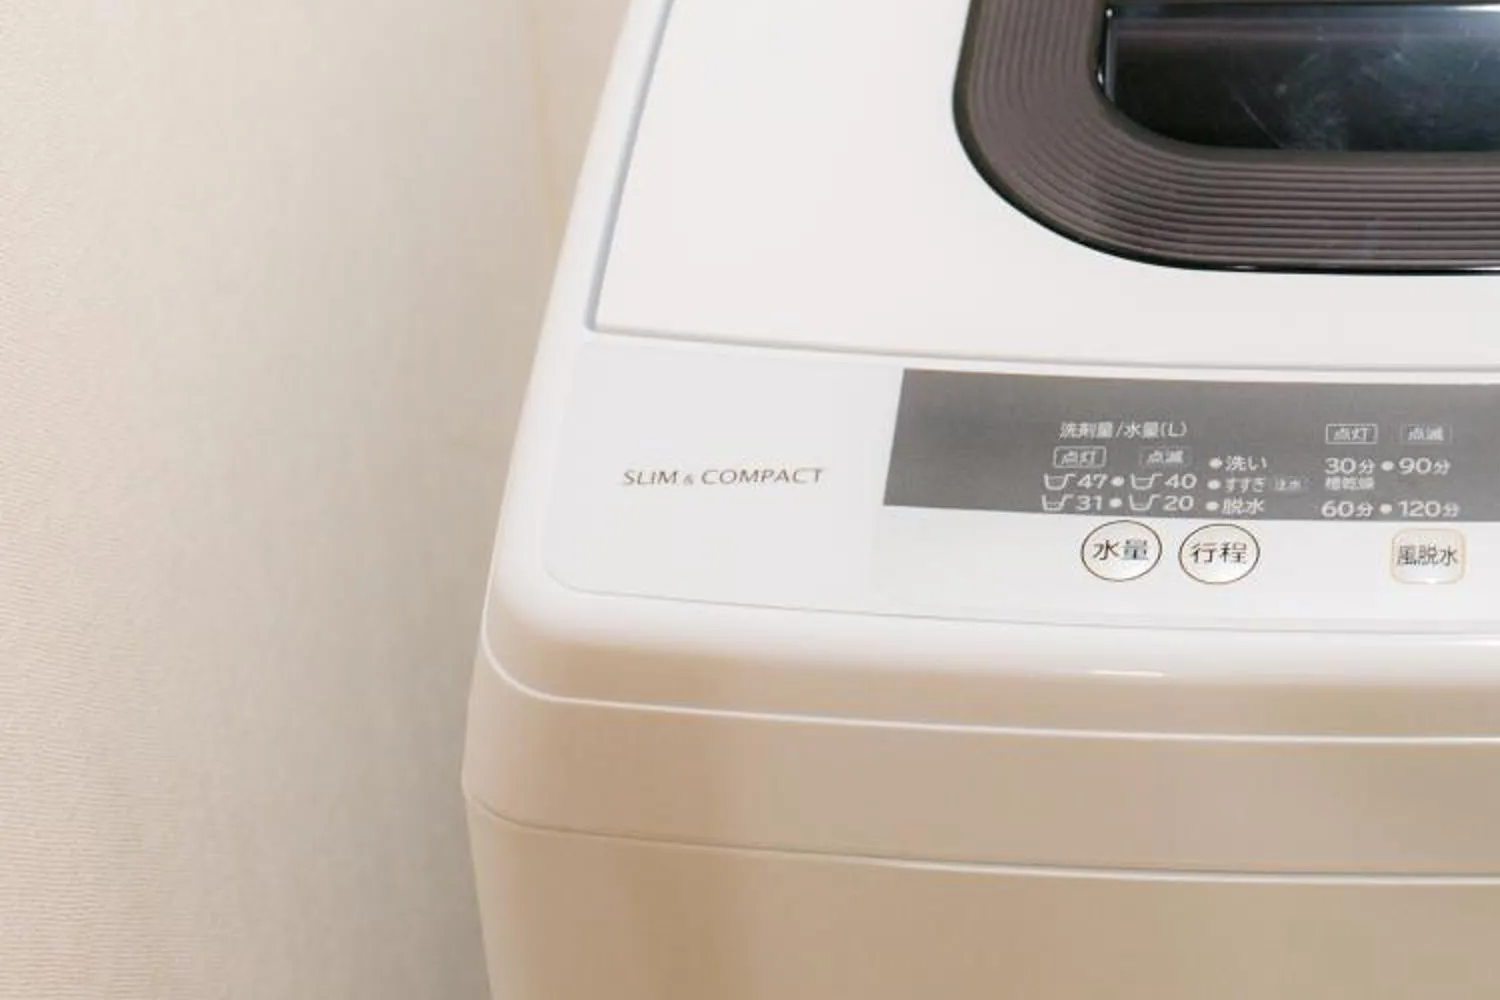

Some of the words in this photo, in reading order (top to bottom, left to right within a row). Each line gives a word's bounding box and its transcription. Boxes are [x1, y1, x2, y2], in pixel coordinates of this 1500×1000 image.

[1333, 427, 1369, 441] 点灯
[1061, 450, 1097, 465] 点灯
[1225, 455, 1267, 471] 洗い
[1324, 457, 1376, 475] 30分
[1399, 457, 1452, 475] 90分
[623, 470, 678, 486] SLIM
[701, 467, 824, 485] COMPACT
[1077, 474, 1106, 489] 47
[1164, 474, 1197, 489] 40
[1075, 495, 1101, 511] 31
[1163, 495, 1194, 511] 20
[1221, 499, 1264, 515] 脱水
[1321, 500, 1374, 518] 60分
[1400, 500, 1460, 518] 120分
[1092, 539, 1149, 561] 水量
[1190, 542, 1249, 565] 行程
